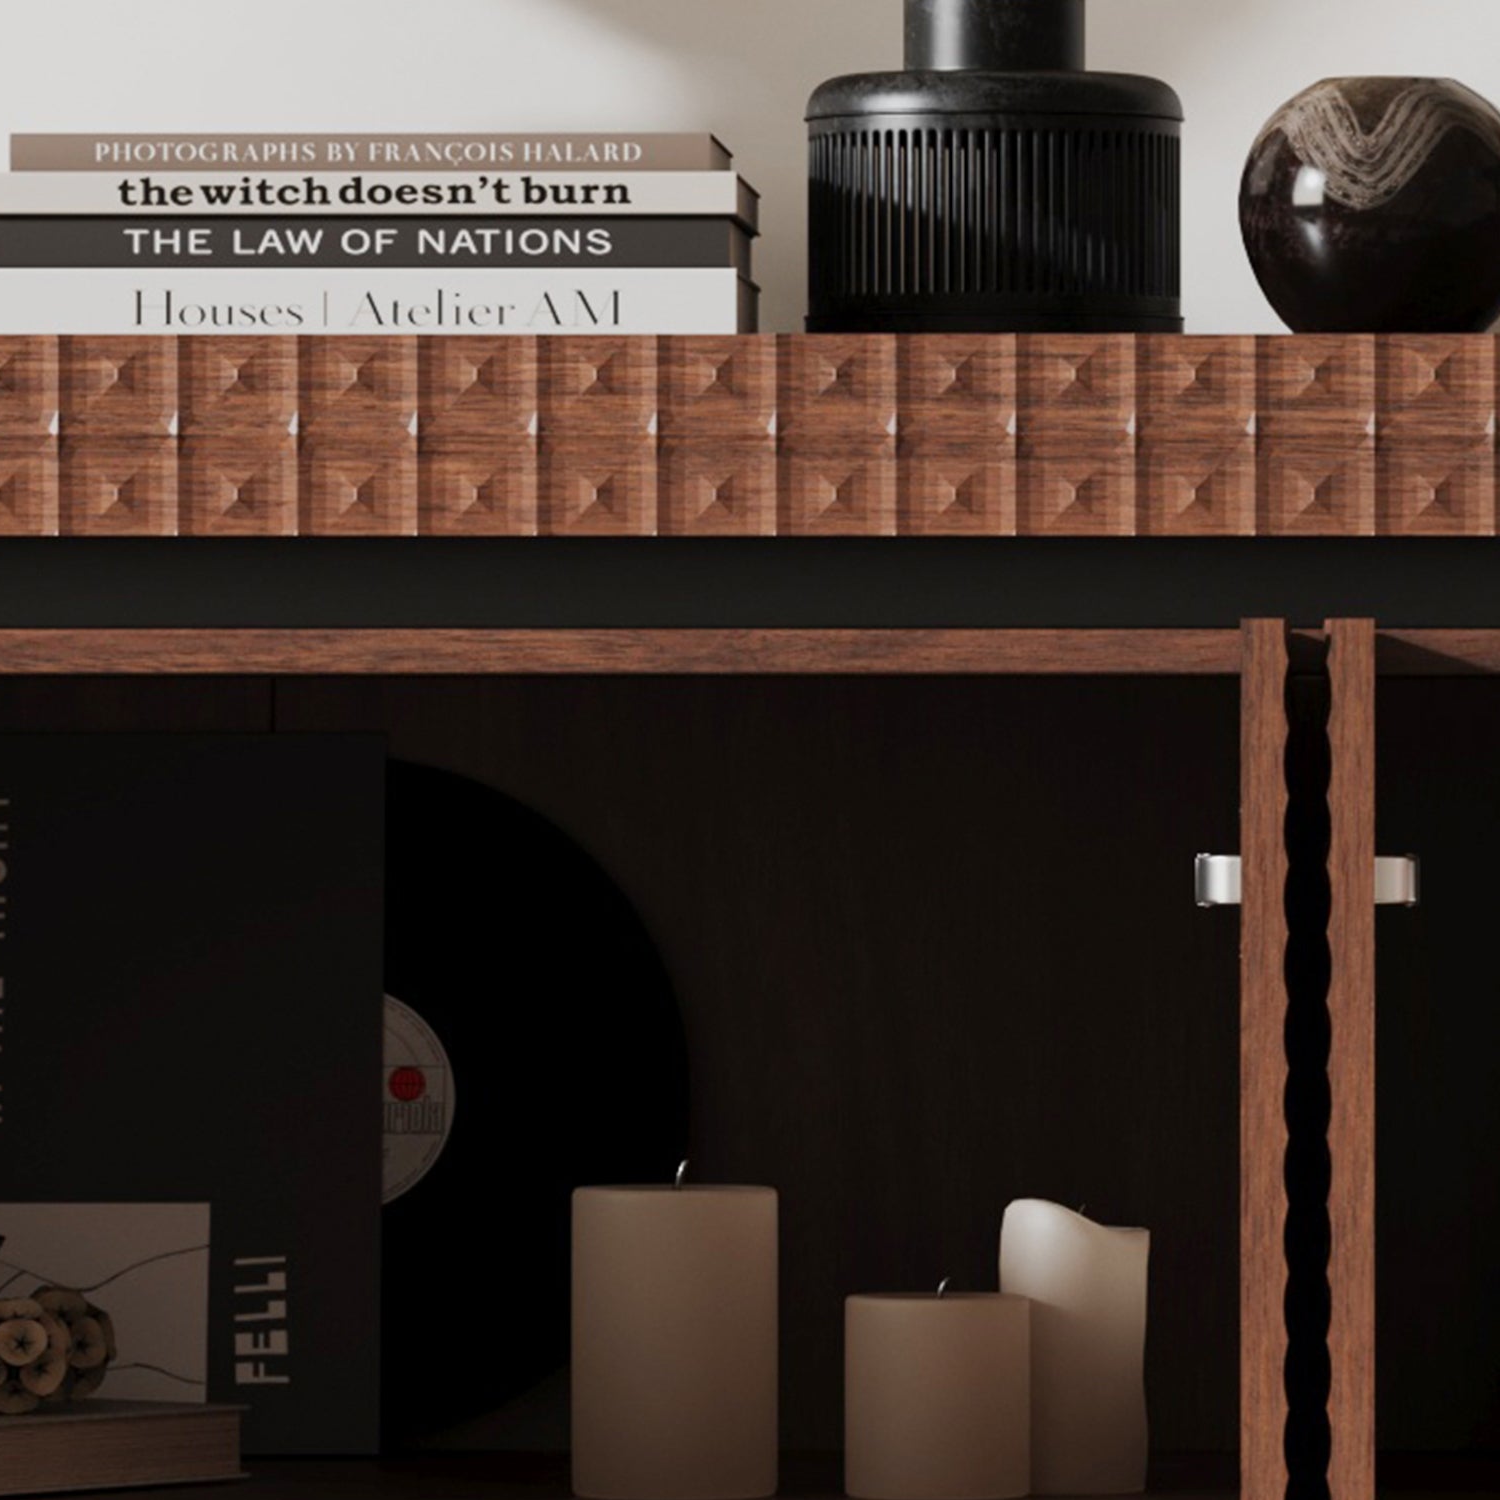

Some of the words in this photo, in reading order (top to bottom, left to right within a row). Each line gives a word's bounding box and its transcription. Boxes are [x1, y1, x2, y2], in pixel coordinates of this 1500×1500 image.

[95, 141, 316, 162] PHOTOGRAPHS
[327, 141, 359, 162] BY
[369, 141, 514, 166] FRANÇOIS
[523, 141, 642, 162] HALARD
[118, 177, 193, 206] the
[200, 176, 331, 206] witch
[520, 176, 631, 204] burn
[122, 228, 213, 255] THE
[233, 228, 324, 255] LAW
[340, 228, 399, 256] OF
[417, 228, 613, 256] NATIONS
[135, 289, 304, 326] Houses
[349, 288, 516, 327] Atelier
[526, 288, 621, 327] AM
[233, 1255, 291, 1385] FELLI
